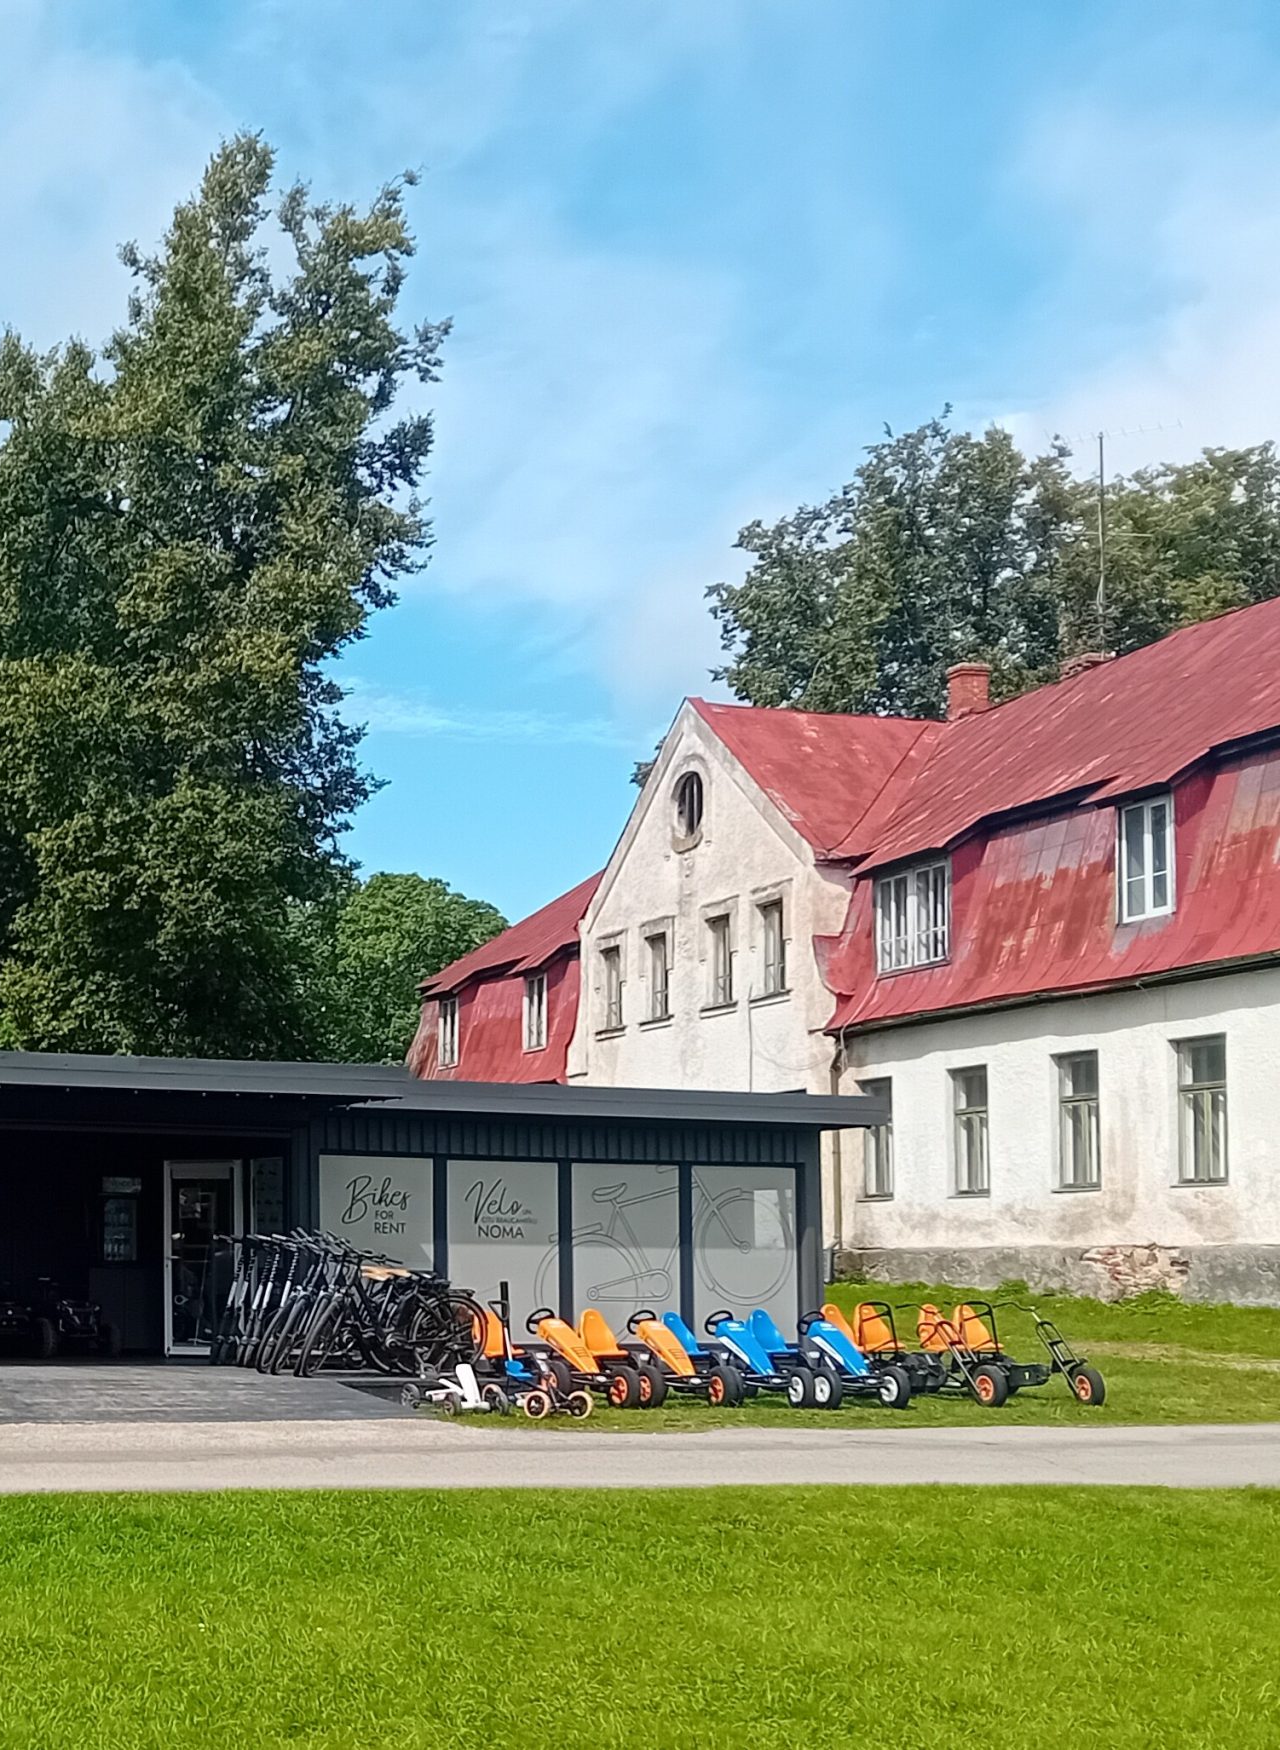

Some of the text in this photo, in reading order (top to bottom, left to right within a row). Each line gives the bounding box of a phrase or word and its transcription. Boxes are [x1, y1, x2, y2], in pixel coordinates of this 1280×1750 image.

[341, 1175, 412, 1225] Bikes
[464, 1178, 522, 1225] Velo
[375, 1210, 394, 1220] FOR
[374, 1222, 406, 1234] RENT
[478, 1224, 524, 1238] NOMA
